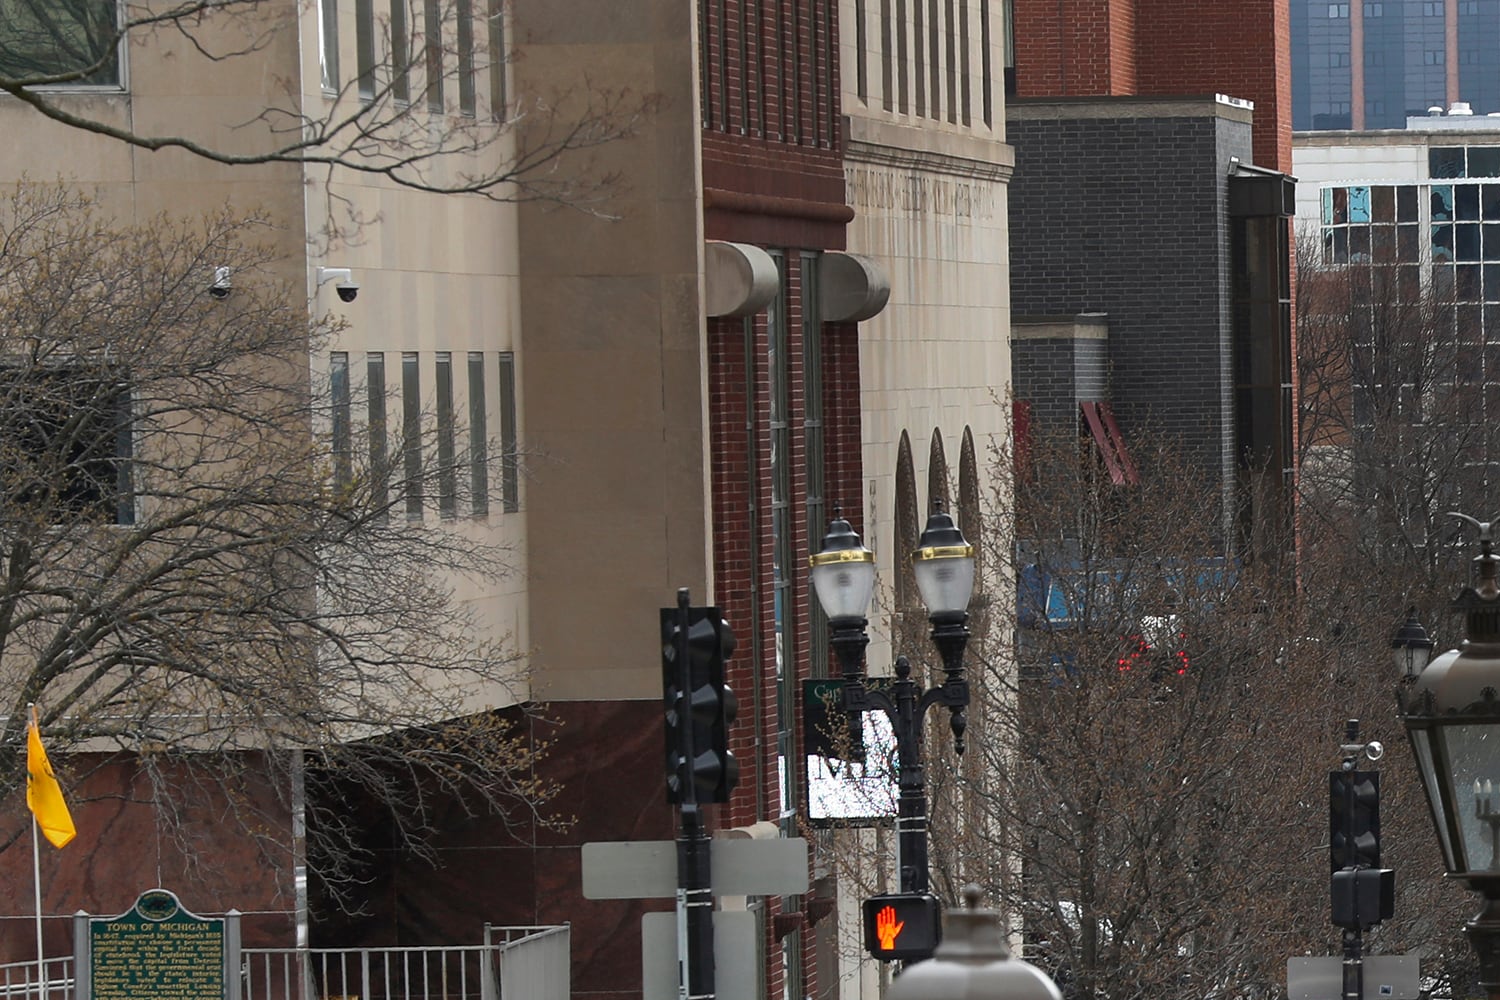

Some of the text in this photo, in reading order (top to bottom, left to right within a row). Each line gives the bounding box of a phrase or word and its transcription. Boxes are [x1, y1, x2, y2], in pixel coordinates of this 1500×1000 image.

[107, 923, 209, 931] TOWN OF MICHIGAN
